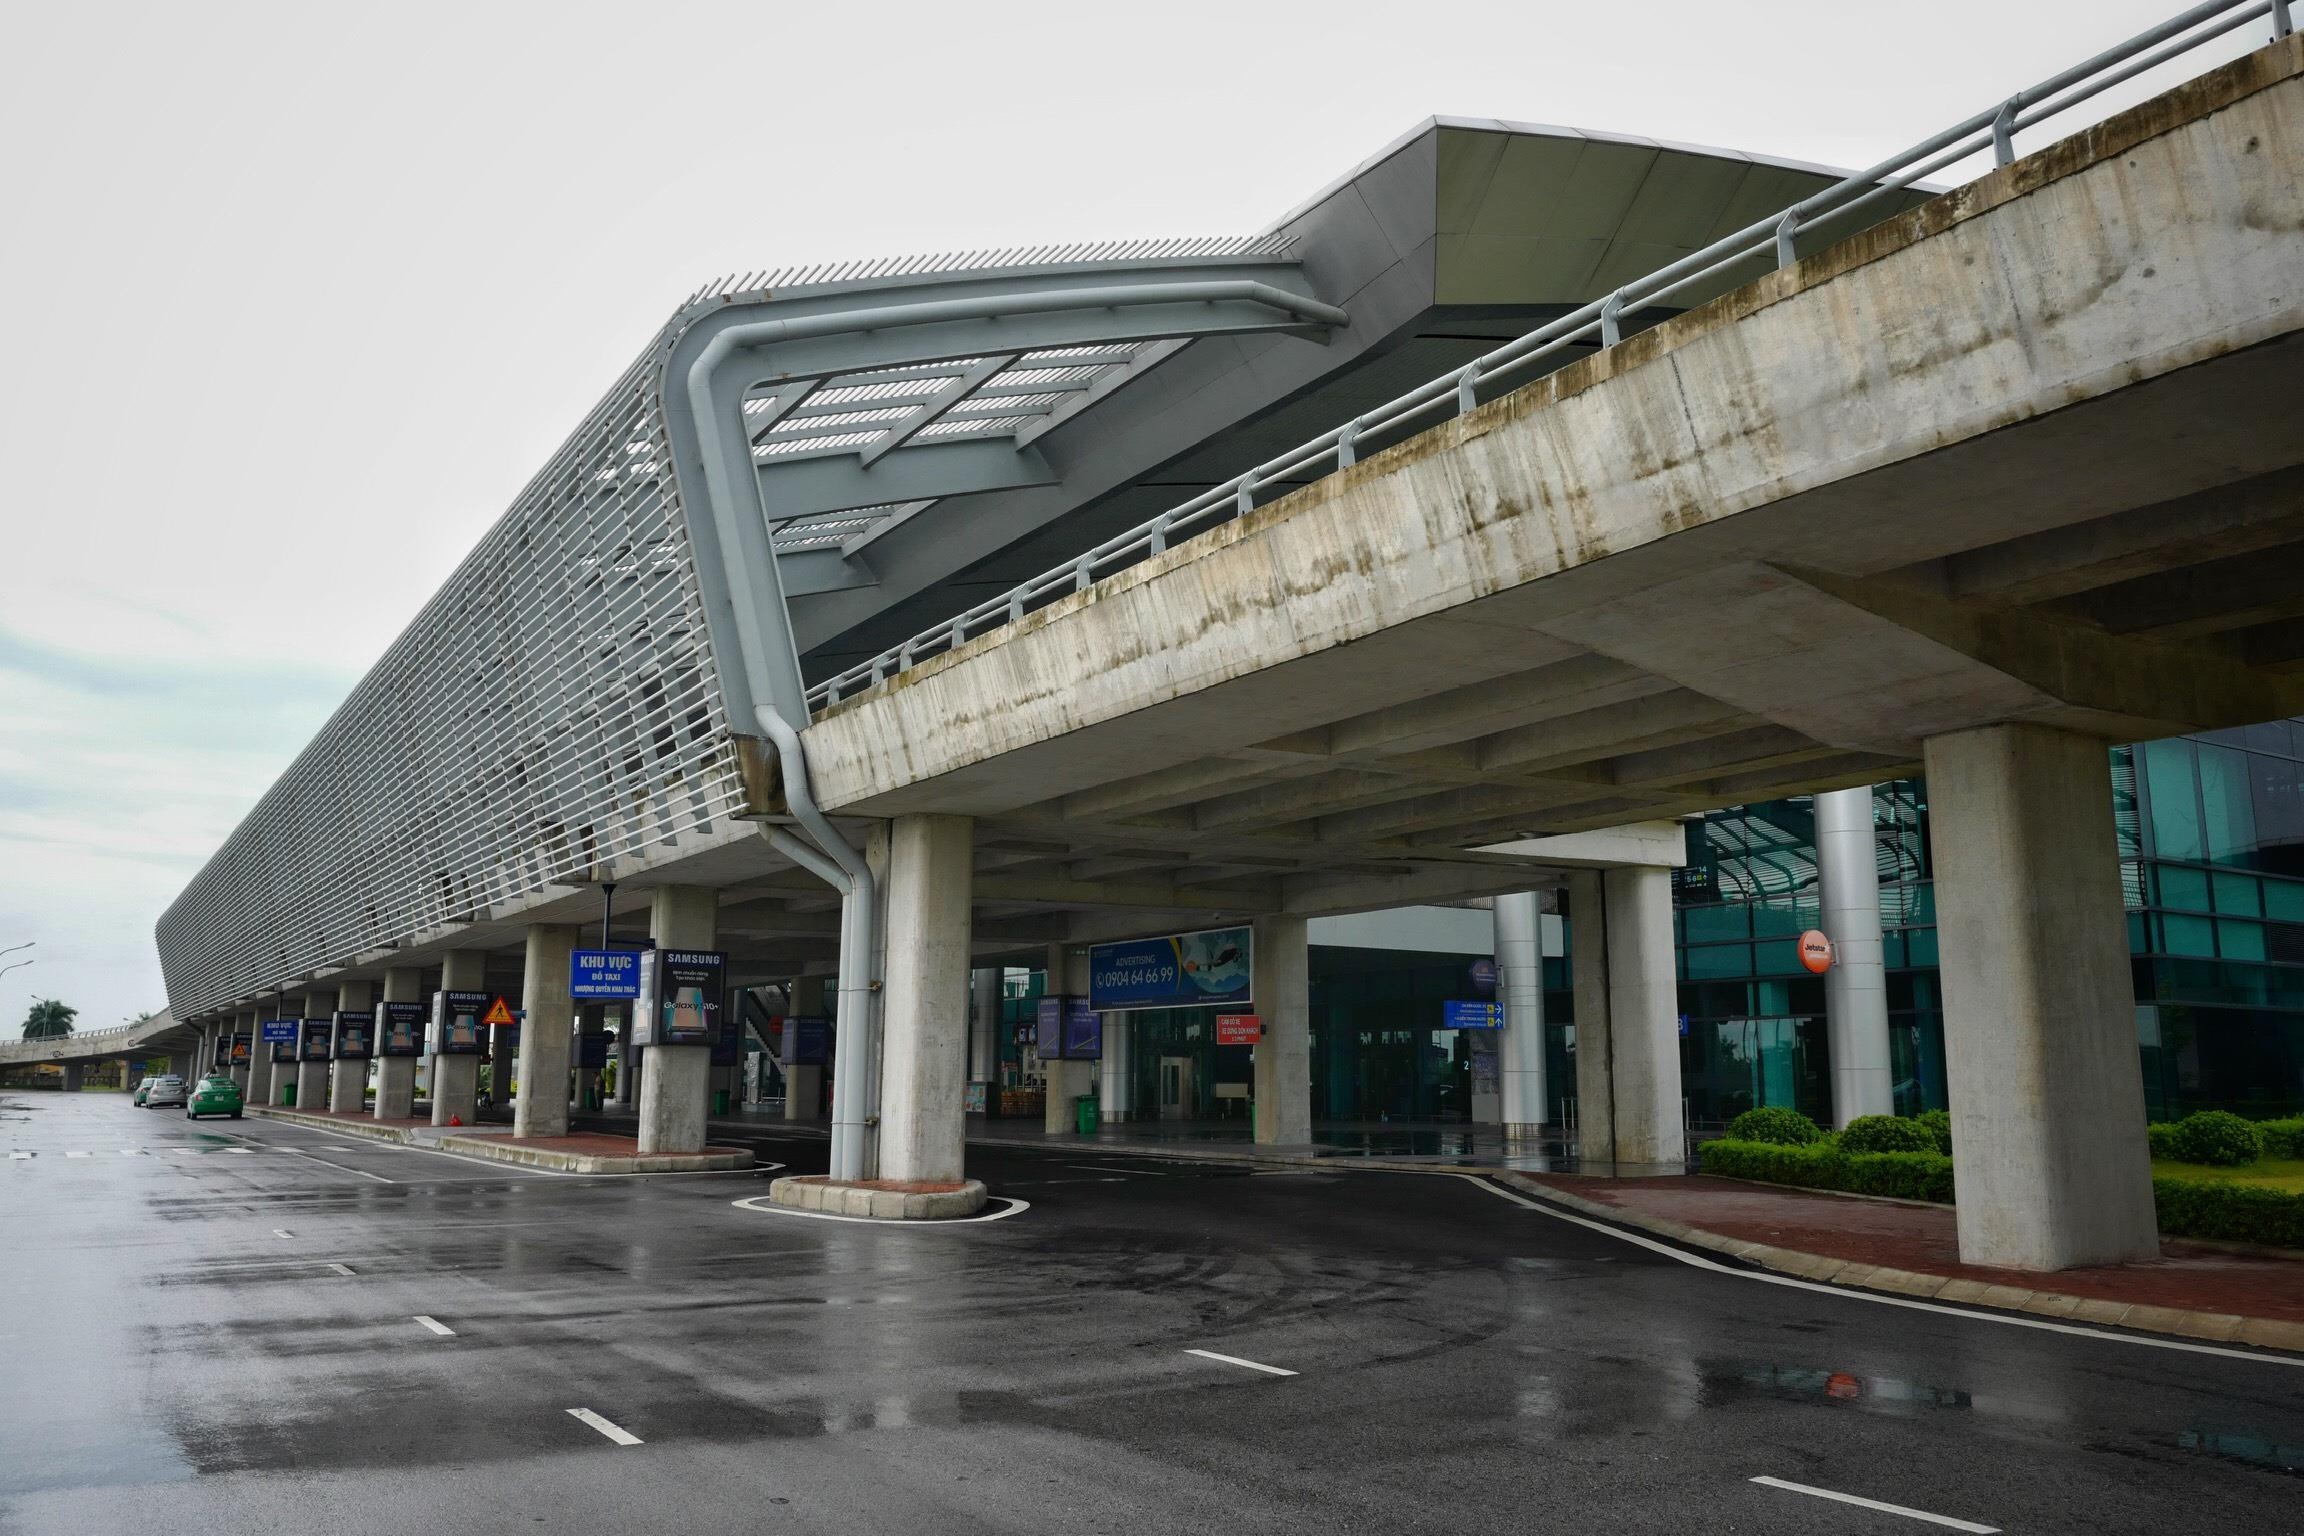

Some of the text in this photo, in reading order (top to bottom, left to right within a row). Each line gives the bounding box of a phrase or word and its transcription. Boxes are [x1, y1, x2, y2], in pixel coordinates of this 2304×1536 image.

[1805, 944, 1826, 952] Jetstar
[580, 955, 605, 968] KHU
[608, 954, 632, 971] VỰC
[667, 953, 720, 965] SAMSUNG
[1115, 954, 1156, 967] ADVERTISING
[605, 973, 621, 981] TAXI
[1105, 966, 1174, 987] 0904 64 66 99
[664, 1001, 699, 1011] Galaxy
[1463, 1061, 1470, 1070] 2
